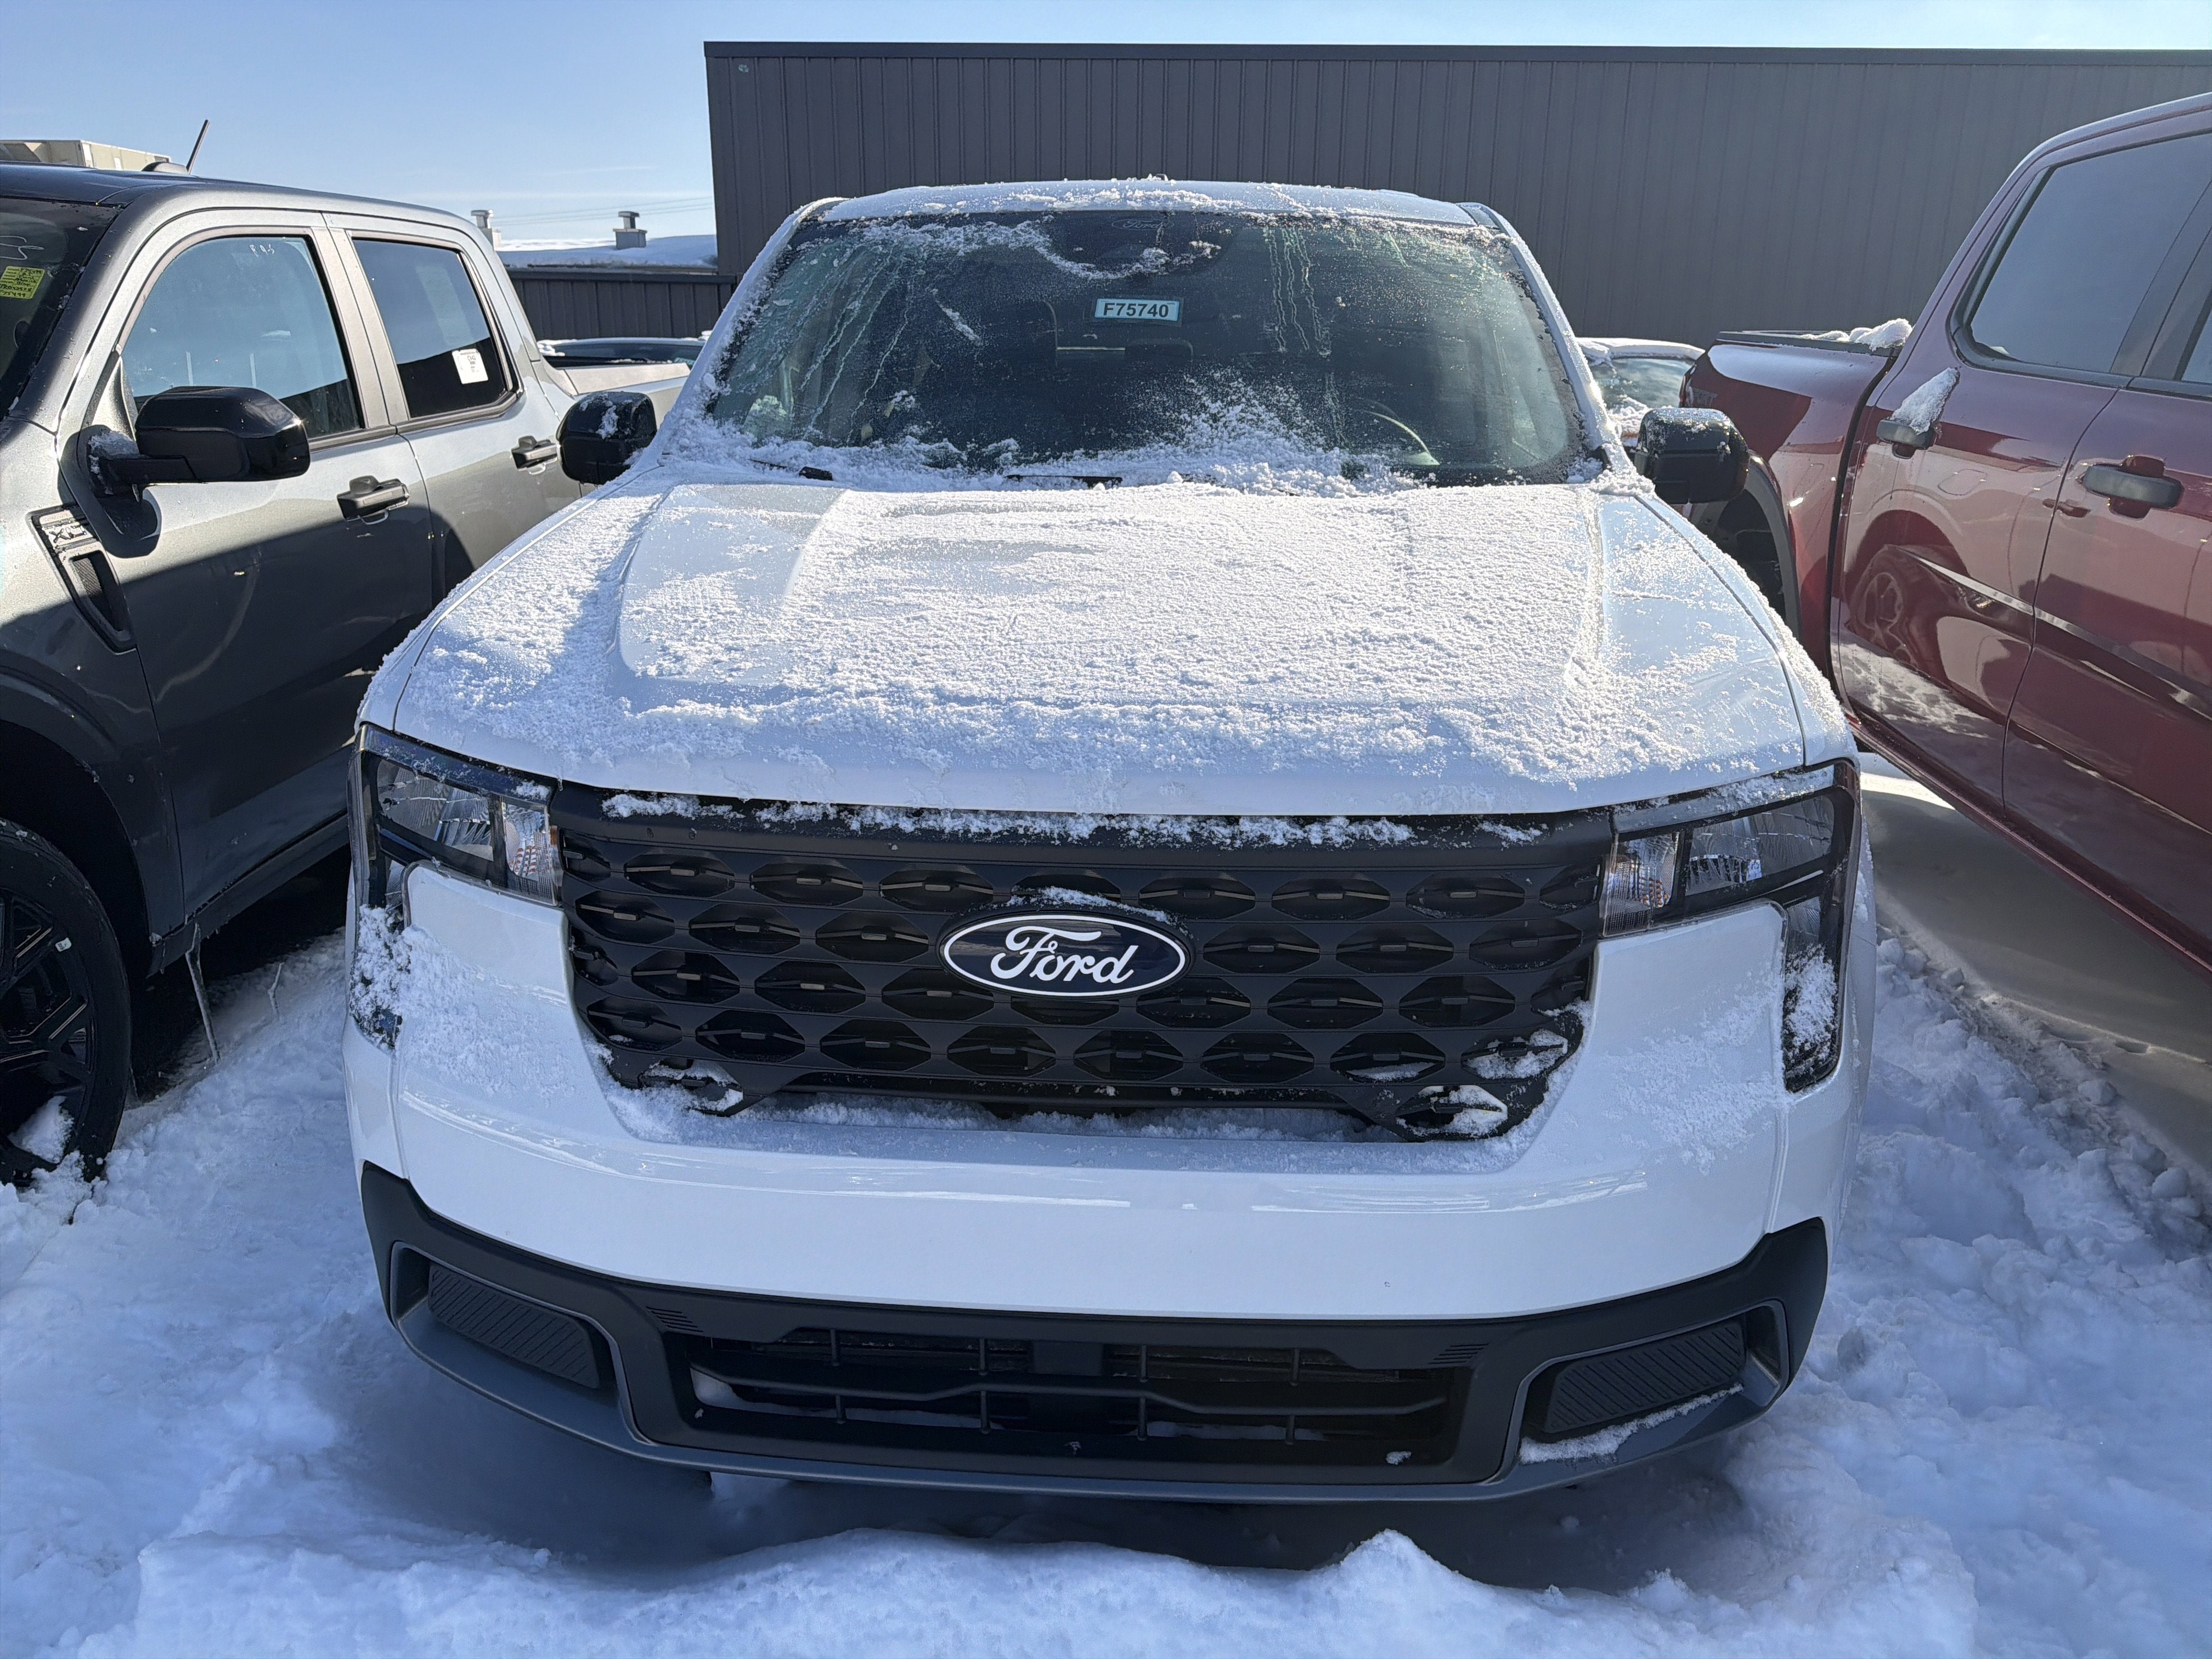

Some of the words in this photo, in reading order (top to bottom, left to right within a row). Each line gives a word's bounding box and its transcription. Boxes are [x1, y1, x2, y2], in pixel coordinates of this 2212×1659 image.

[1122, 219, 1164, 228] Ford
[1103, 302, 1169, 318] F75740
[990, 926, 1139, 984] Ford
